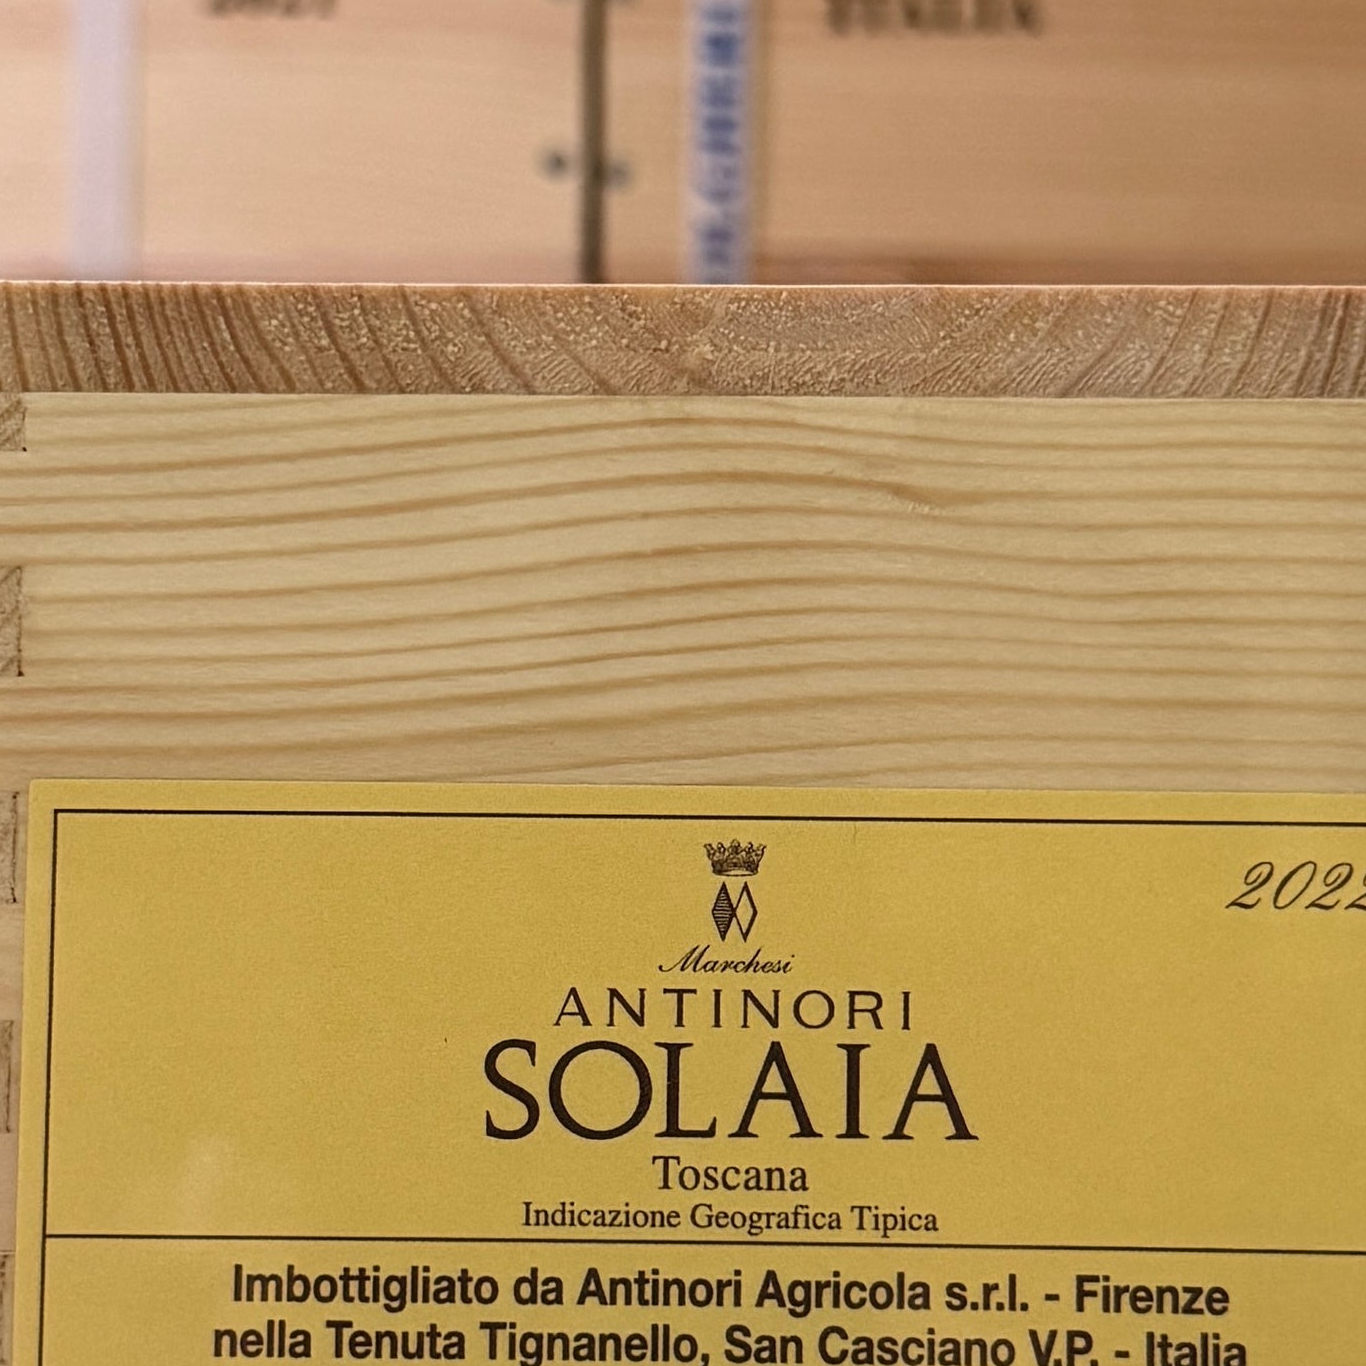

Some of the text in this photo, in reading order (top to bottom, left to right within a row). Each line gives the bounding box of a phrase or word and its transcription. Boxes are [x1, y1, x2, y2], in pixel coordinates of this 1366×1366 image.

[657, 944, 796, 974] Marchesi
[552, 986, 912, 1031] ANTINORI
[483, 1038, 980, 1141] SOLAIA
[651, 1155, 810, 1193] Toscana
[521, 1201, 940, 1239] Indicazione Geografica Tipica
[232, 1263, 500, 1314] Imbottigliato
[512, 1266, 565, 1307] da
[575, 1266, 743, 1309] Antinori
[754, 1269, 932, 1319] Agricola
[944, 1272, 1030, 1313] s.r.l.
[1075, 1274, 1231, 1317] Firenze
[213, 1318, 312, 1360] nella
[324, 1319, 466, 1361] Tenuta
[723, 1323, 804, 1365] San
